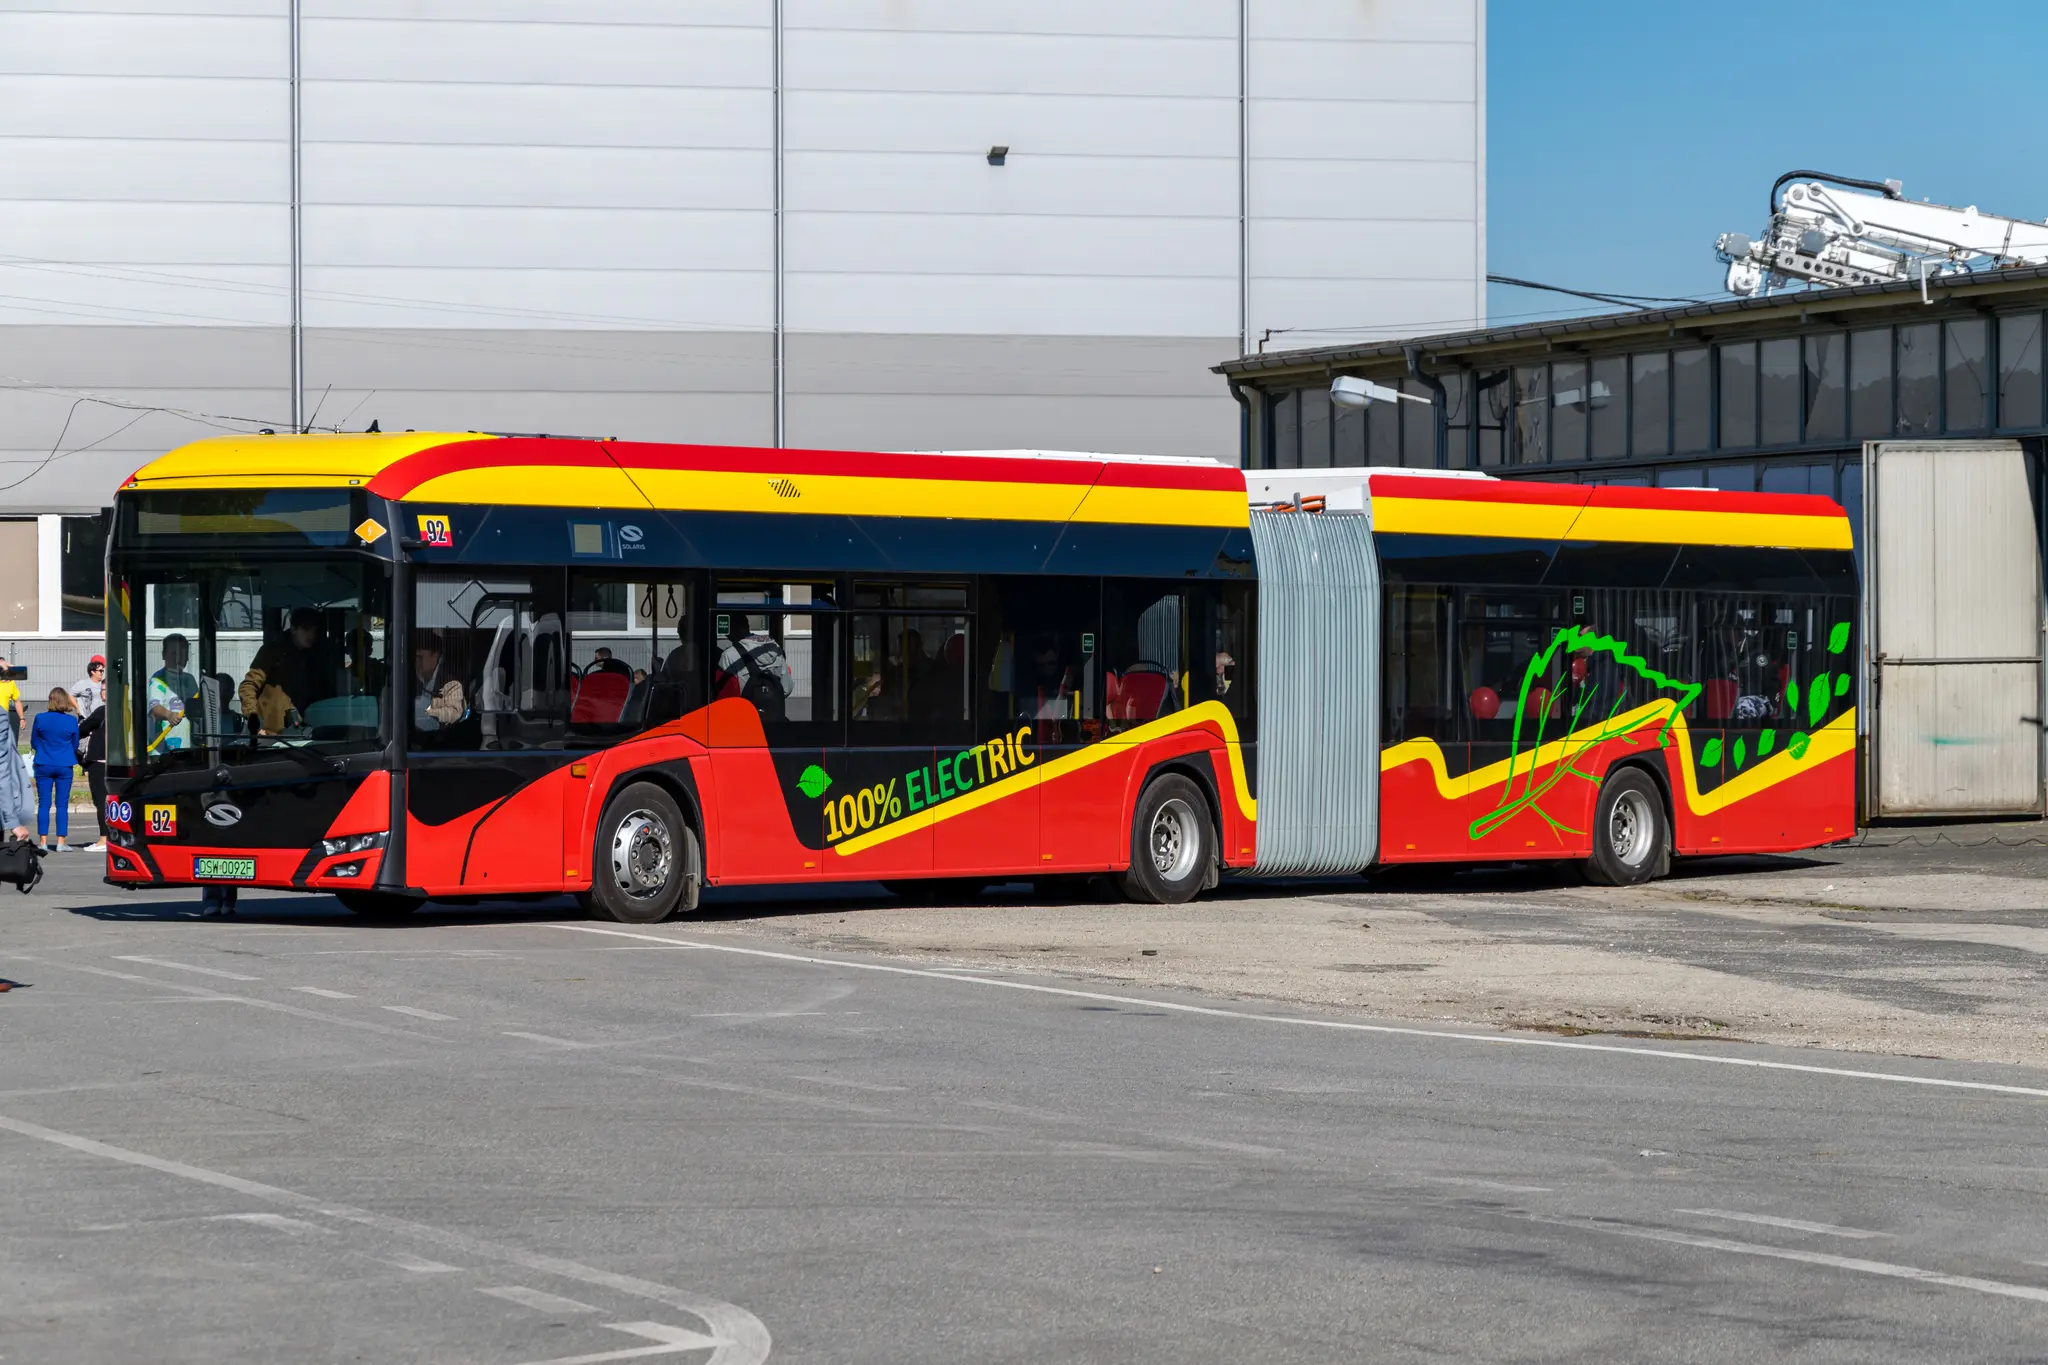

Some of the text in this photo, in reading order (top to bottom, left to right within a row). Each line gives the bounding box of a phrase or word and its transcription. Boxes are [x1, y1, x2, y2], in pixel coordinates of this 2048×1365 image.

[426, 520, 447, 543] 92
[824, 726, 1035, 842] 100% ELECTRIC
[151, 809, 172, 833] 92
[200, 860, 253, 875] DSW 0092F
